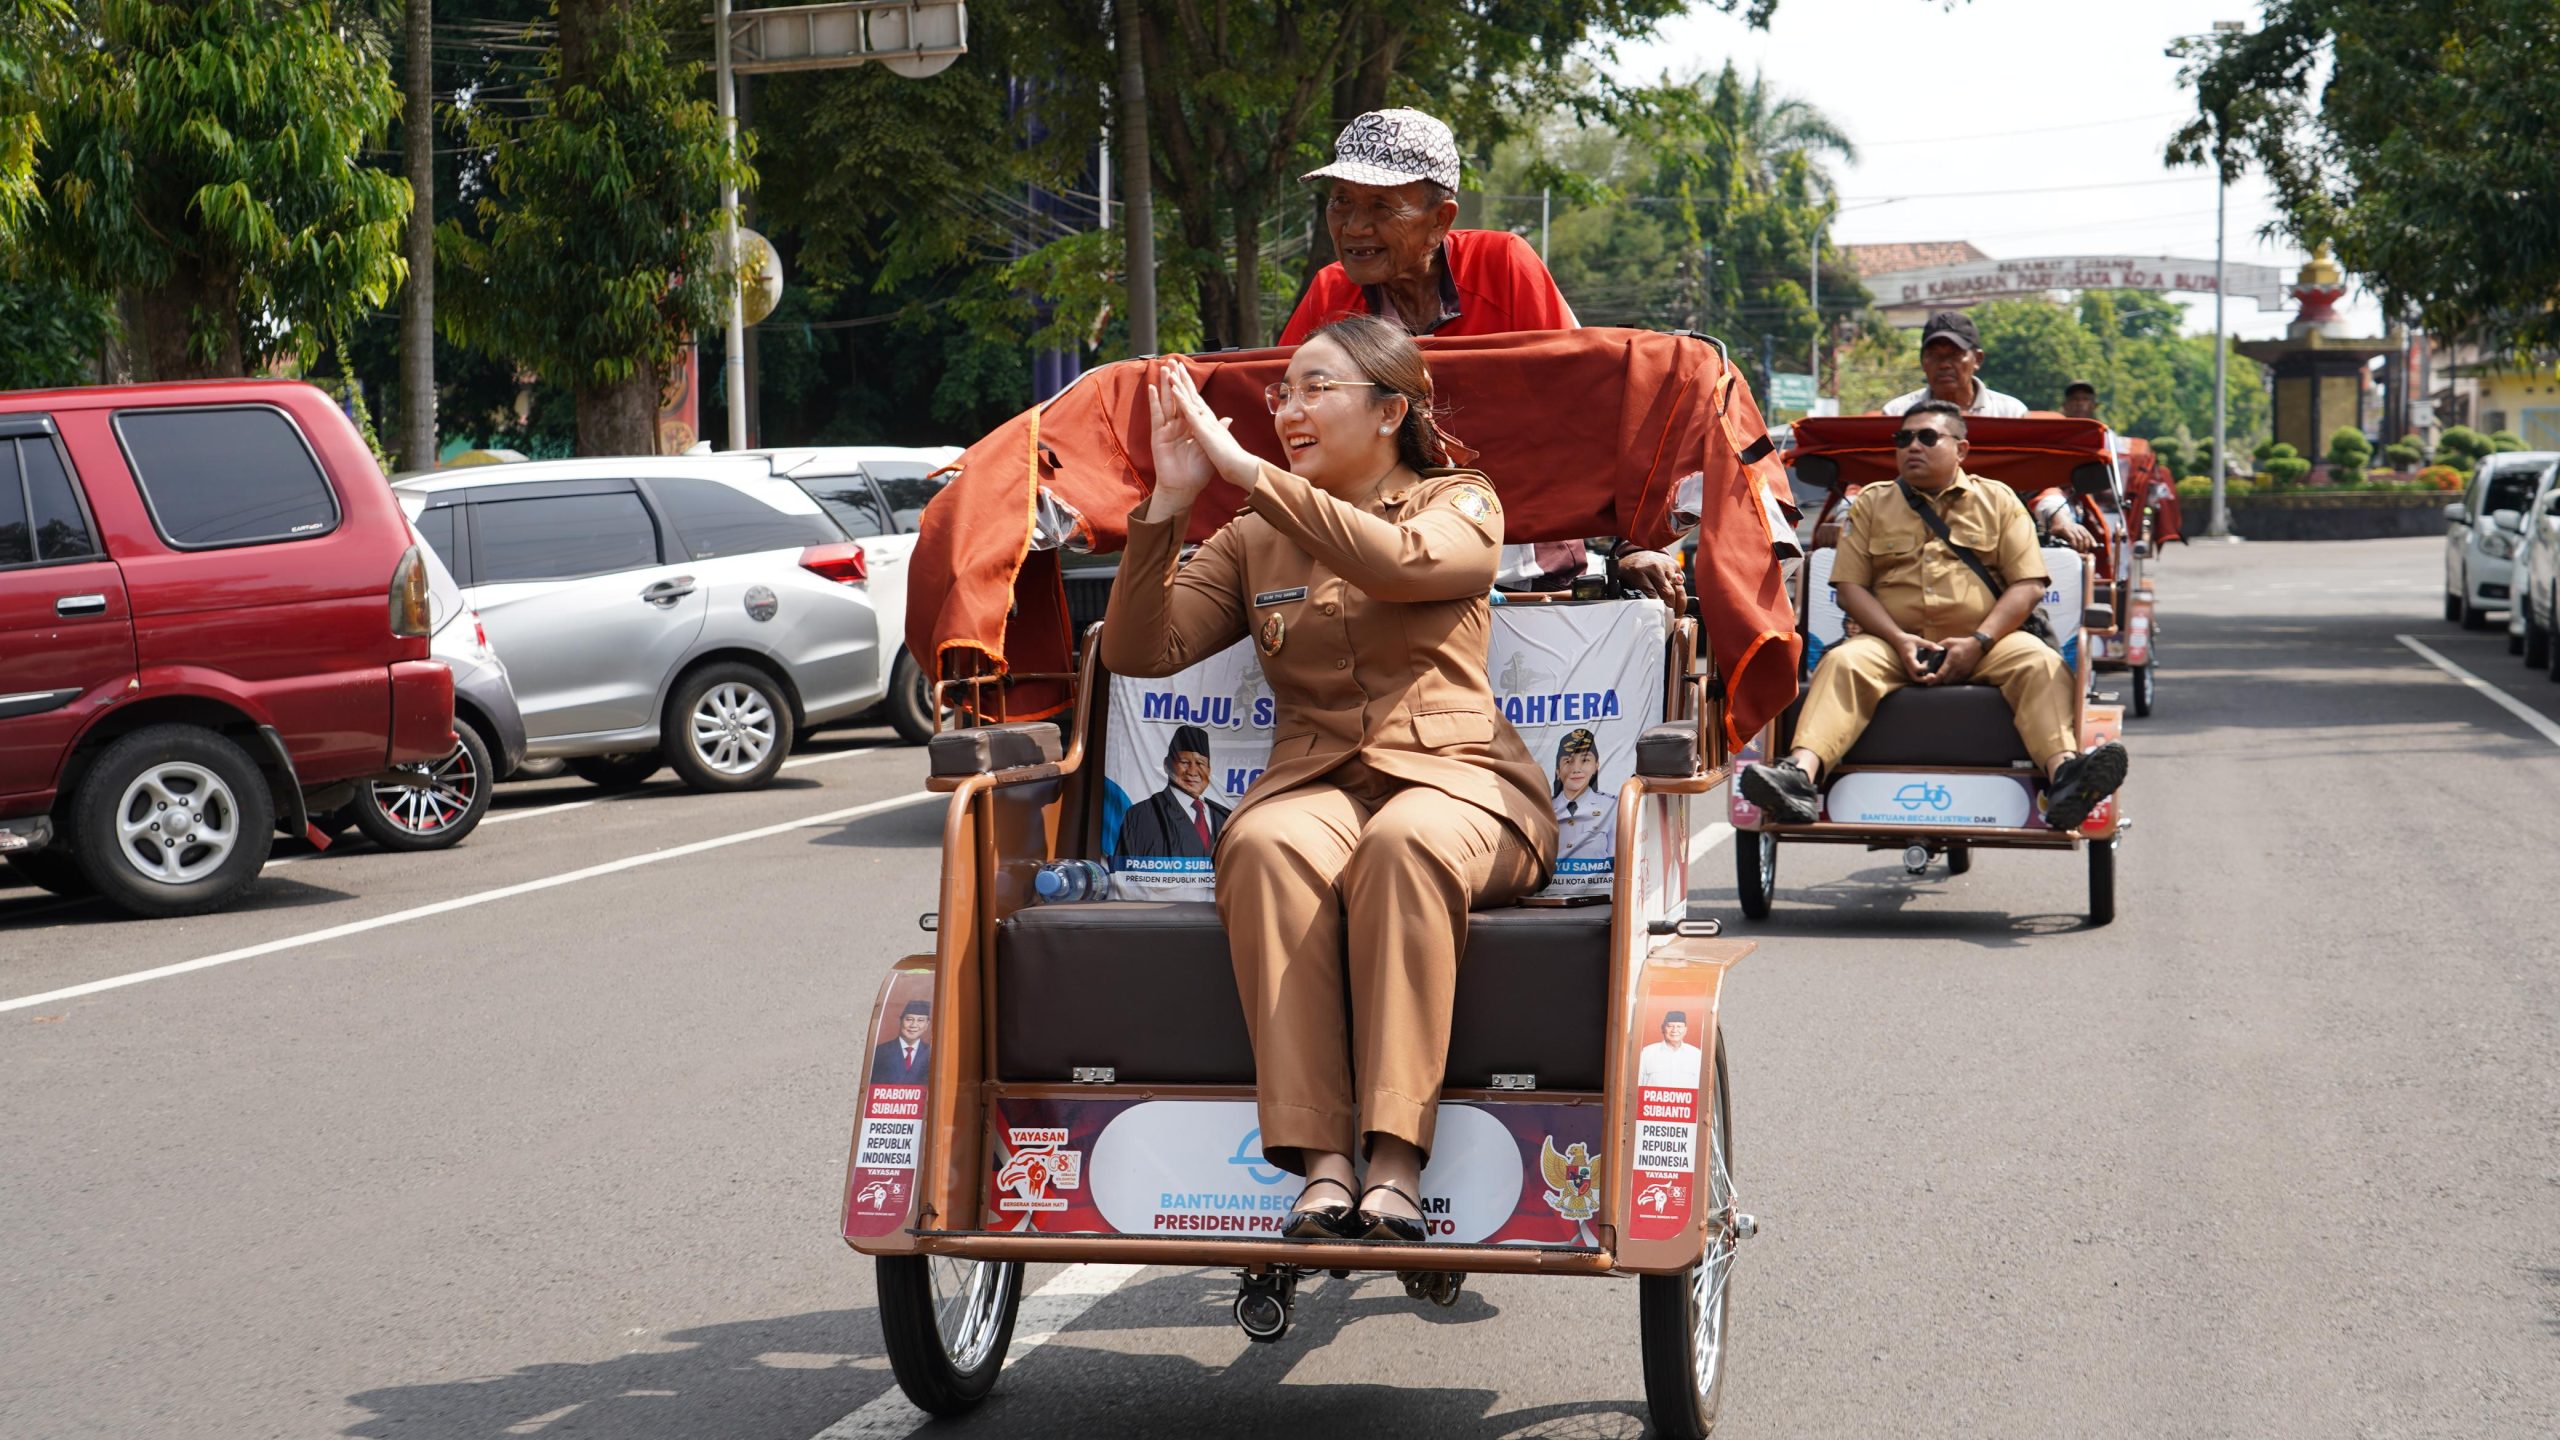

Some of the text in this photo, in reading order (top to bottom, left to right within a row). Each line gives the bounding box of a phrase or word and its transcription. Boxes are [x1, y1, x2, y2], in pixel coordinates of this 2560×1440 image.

[1143, 692, 1241, 727] MAJU,
[1861, 813, 1997, 824] BANTUAN BECAK LISTRIK DARI
[1126, 859, 1183, 870] PRABOWO
[1573, 860, 1612, 872] SAMBA
[1126, 875, 1161, 883] PRESIDEN
[1162, 876, 1197, 884] REPUBLIK
[1551, 876, 1614, 886] ALI KOTA BLITAR
[873, 1088, 921, 1101] PRABOWO
[1643, 1090, 1692, 1104] PRABOWO
[871, 1102, 918, 1116] SUBIANTO
[1643, 1105, 1691, 1119] SUBIANTO
[869, 1122, 914, 1136] PRESIDEN
[1642, 1125, 1688, 1138] PRESIDEN
[867, 1137, 911, 1150] REPUBLIK
[1013, 1132, 1065, 1142] YAYASAN
[1642, 1139, 1687, 1153] REPUBLIK
[862, 1151, 912, 1165] INDONESIA
[1638, 1154, 1689, 1168] INDONESIA
[1645, 1171, 1679, 1179] YAYASAN
[1161, 1193, 1254, 1210] BANTUAN
[1154, 1214, 1245, 1231] PRESIDEN
